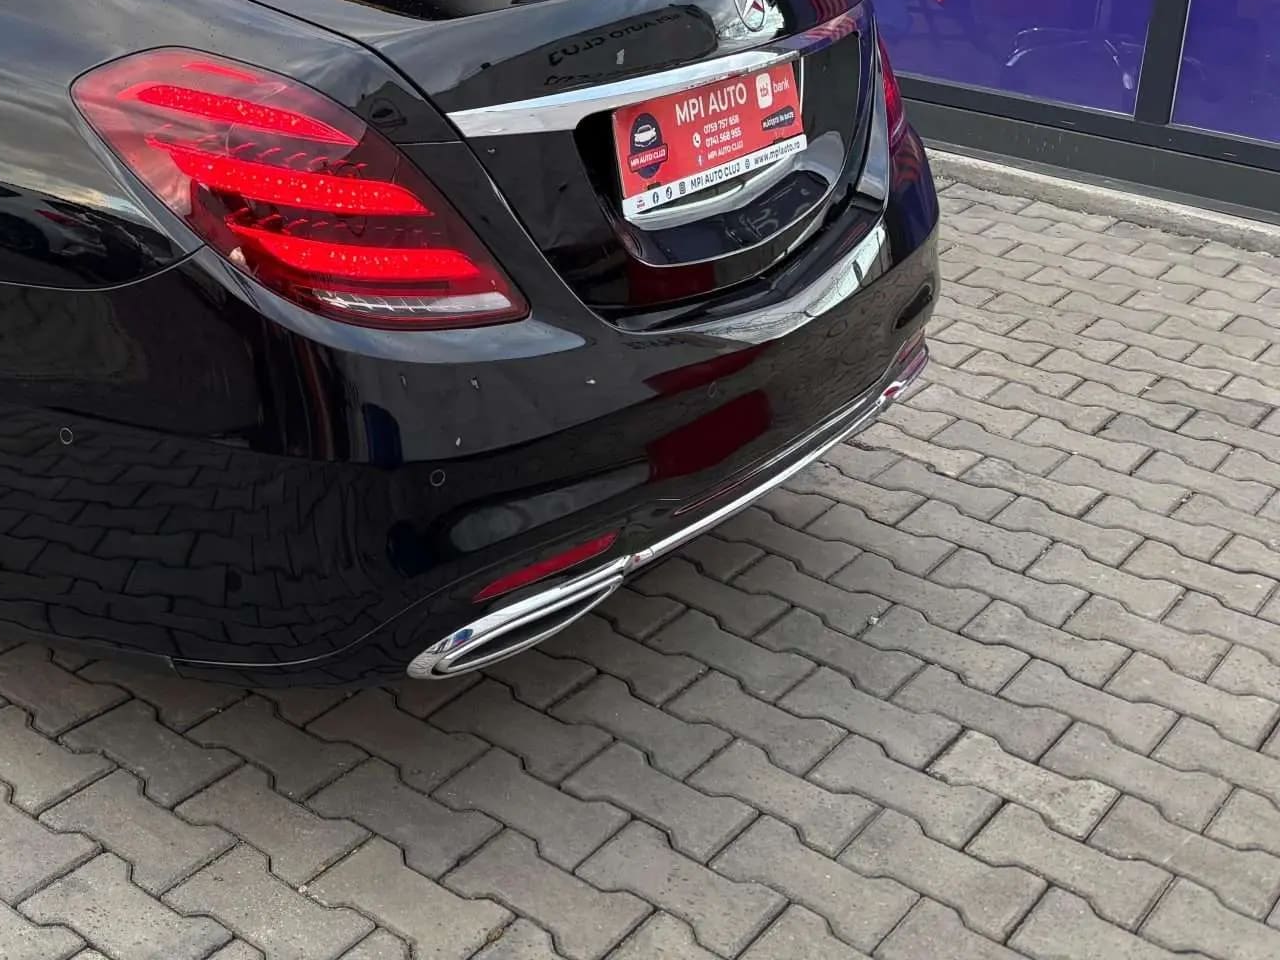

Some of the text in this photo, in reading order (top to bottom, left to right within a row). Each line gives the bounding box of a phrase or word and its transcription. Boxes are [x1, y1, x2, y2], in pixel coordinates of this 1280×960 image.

[675, 83, 747, 126] MPI AUTO
[690, 162, 740, 190] MPI AUTO CLUJ
